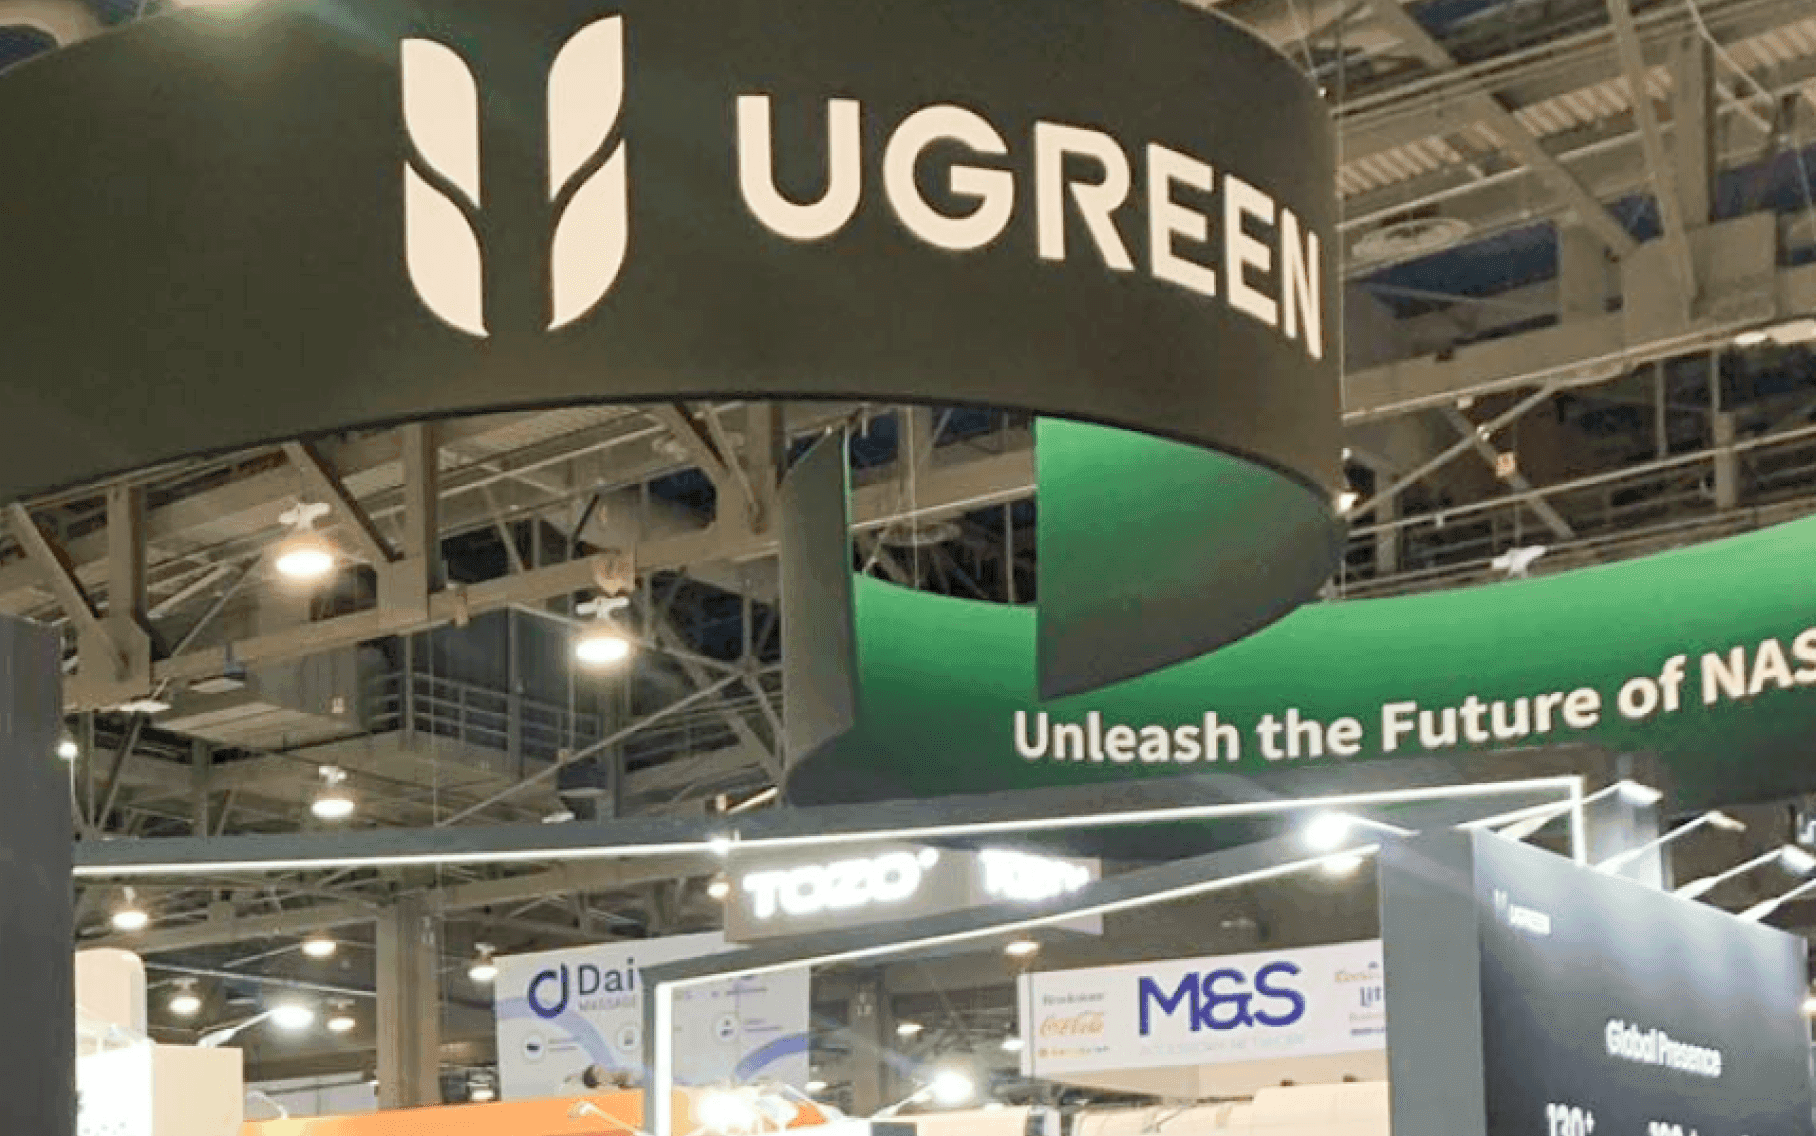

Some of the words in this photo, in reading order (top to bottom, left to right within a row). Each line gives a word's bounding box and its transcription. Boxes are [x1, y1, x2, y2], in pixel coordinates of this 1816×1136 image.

[736, 95, 1323, 359] UGREEN
[1014, 710, 1240, 762] Unleash
[1256, 708, 1363, 760] the
[1381, 688, 1601, 752] Future
[1617, 654, 1687, 718] of
[1700, 627, 1816, 705] NAS
[577, 957, 641, 996] Dai
[1138, 960, 1306, 1037] M&S
